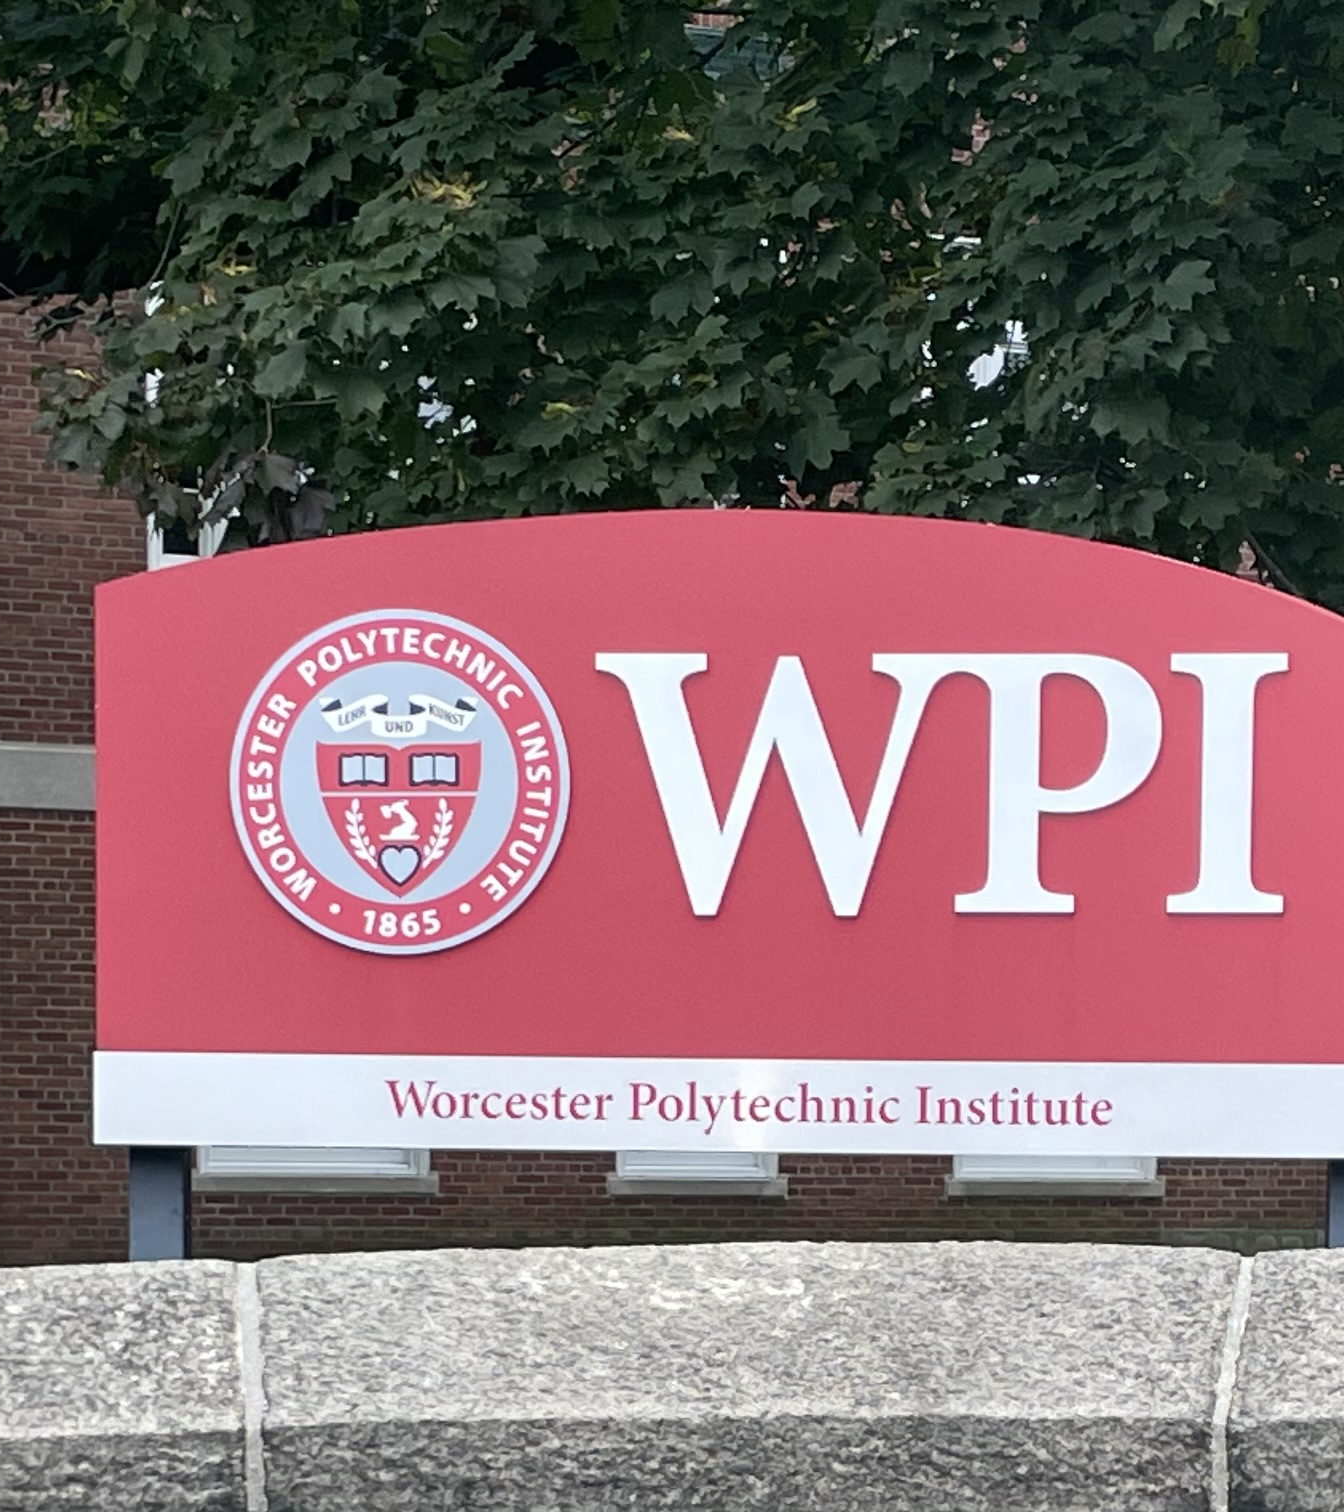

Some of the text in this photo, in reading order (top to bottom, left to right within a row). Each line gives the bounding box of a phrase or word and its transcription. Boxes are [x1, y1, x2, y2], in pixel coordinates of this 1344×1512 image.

[383, 720, 415, 734] UND
[246, 627, 552, 902] WORCESTER POLYTECHNIC INSTITUTE
[594, 651, 1290, 918] WPI
[362, 909, 442, 938] 1865
[384, 1078, 1113, 1132] Worcester Polytechnic Institute
